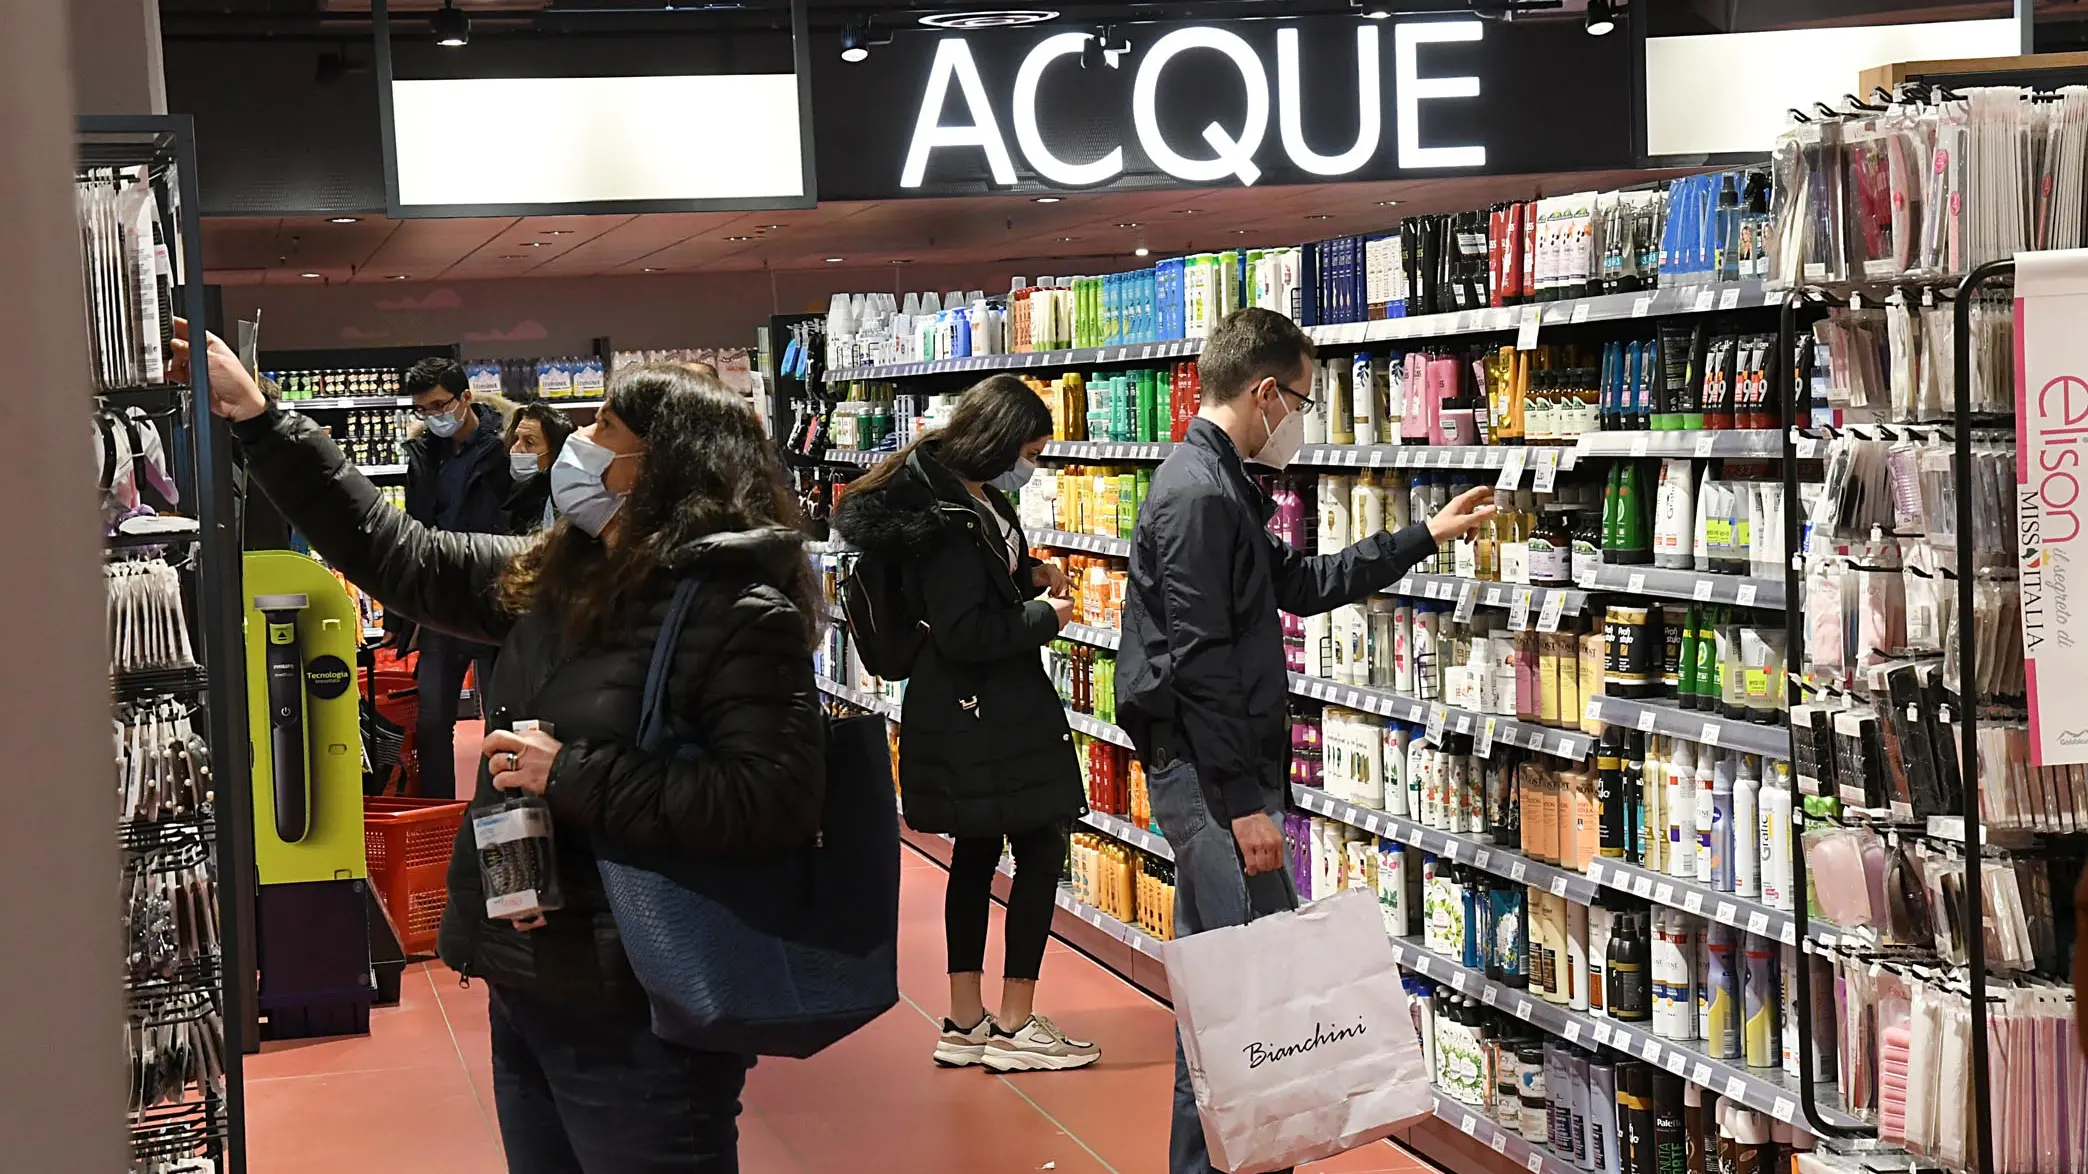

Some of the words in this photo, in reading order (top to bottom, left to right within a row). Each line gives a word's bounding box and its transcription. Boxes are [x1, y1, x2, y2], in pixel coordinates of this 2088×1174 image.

[900, 20, 1486, 187] ACQUE
[2039, 375, 2088, 543] elison
[2021, 491, 2040, 546] MISS
[2053, 547, 2070, 563] il
[2023, 571, 2045, 648] ITALIA
[2045, 564, 2072, 625] segreto
[2057, 630, 2076, 648] di
[307, 671, 348, 679] Tecnologia
[1243, 1015, 1366, 1068] Bianchini
